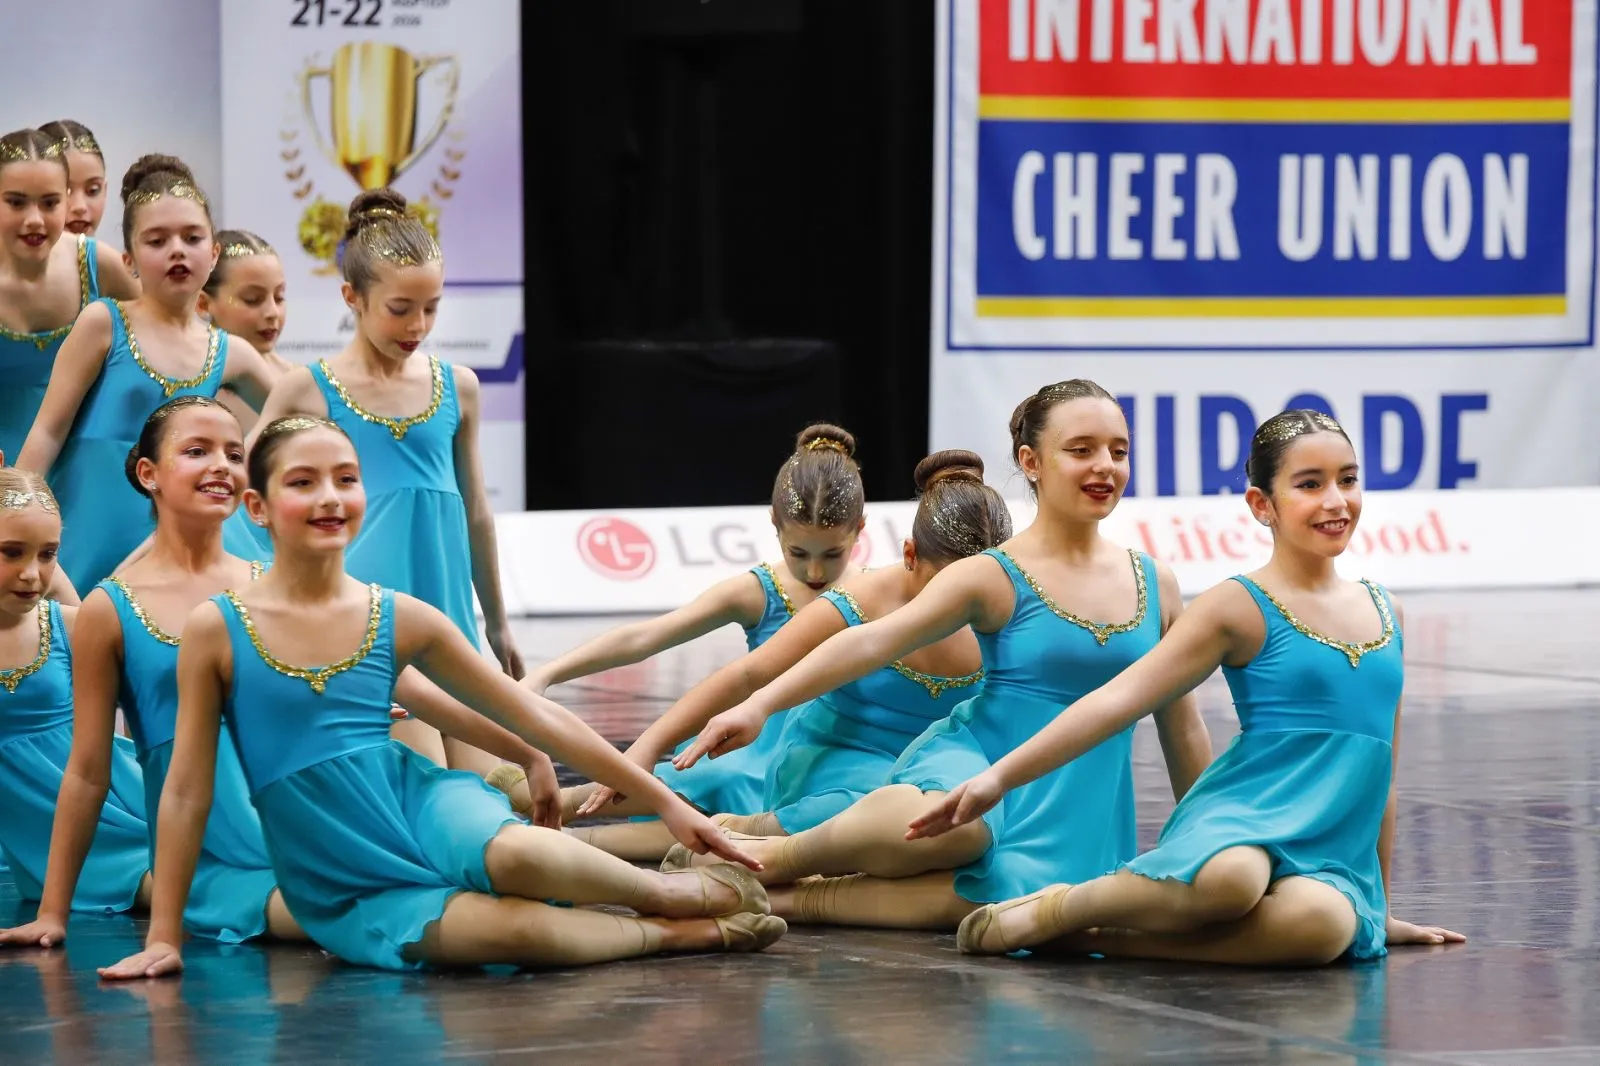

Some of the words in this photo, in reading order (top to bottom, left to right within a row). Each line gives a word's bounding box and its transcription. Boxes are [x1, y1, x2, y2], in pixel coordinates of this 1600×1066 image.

[290, 0, 382, 27] 21-22
[1012, 150, 1241, 261] CHEER
[1277, 152, 1530, 262] UNION
[667, 523, 760, 567] LG
[1349, 508, 1471, 556] ood.
